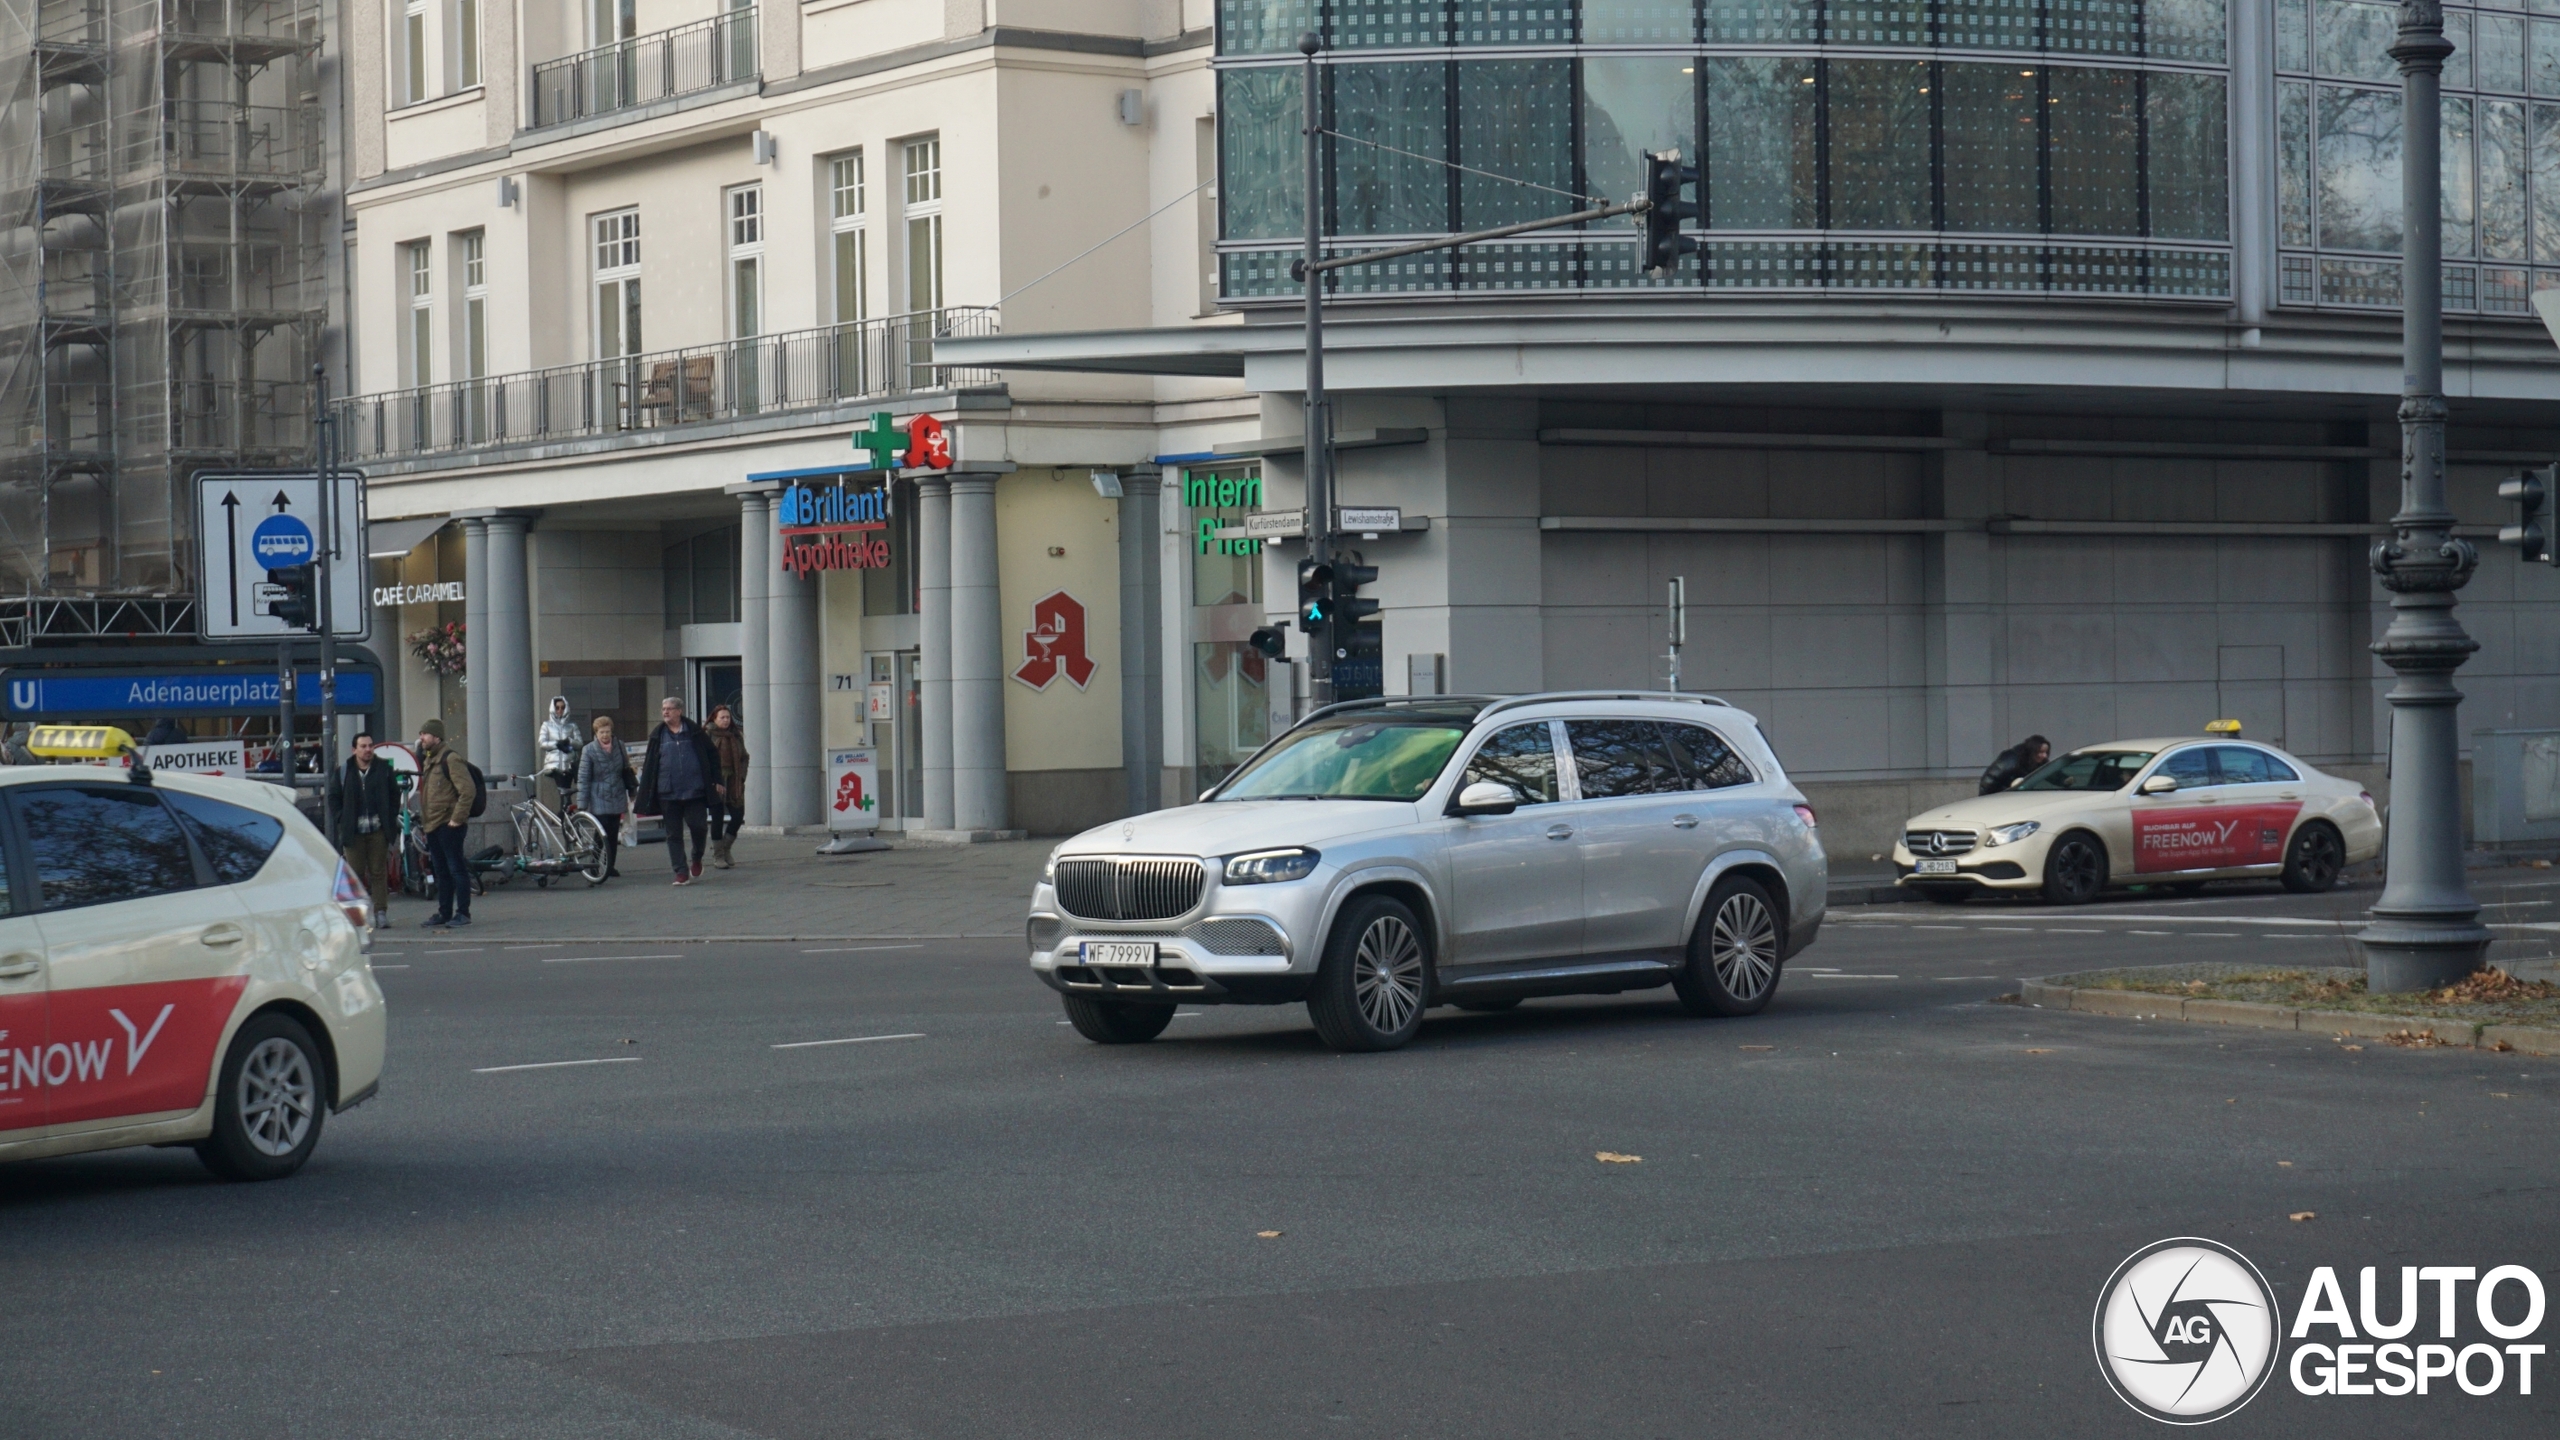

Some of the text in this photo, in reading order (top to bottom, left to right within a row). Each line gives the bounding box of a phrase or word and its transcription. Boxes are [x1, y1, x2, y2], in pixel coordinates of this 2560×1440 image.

[1183, 469, 1262, 508] Intern
[799, 485, 886, 525] Brillant
[1249, 517, 1301, 531] Kurfürstendamm
[1344, 512, 1395, 527] Lewishamstraße
[1199, 517, 1260, 556] Pha
[781, 532, 891, 581] Apotheke
[373, 581, 465, 607] CAFÉ CARAMEL
[835, 675, 852, 690] 71
[13, 678, 280, 709] U Adenauerplatz
[41, 730, 98, 748] TAXI
[153, 750, 238, 770] APOTHEKE
[2143, 830, 2216, 849] FREENOW
[1088, 944, 1151, 963] WF 7999V
